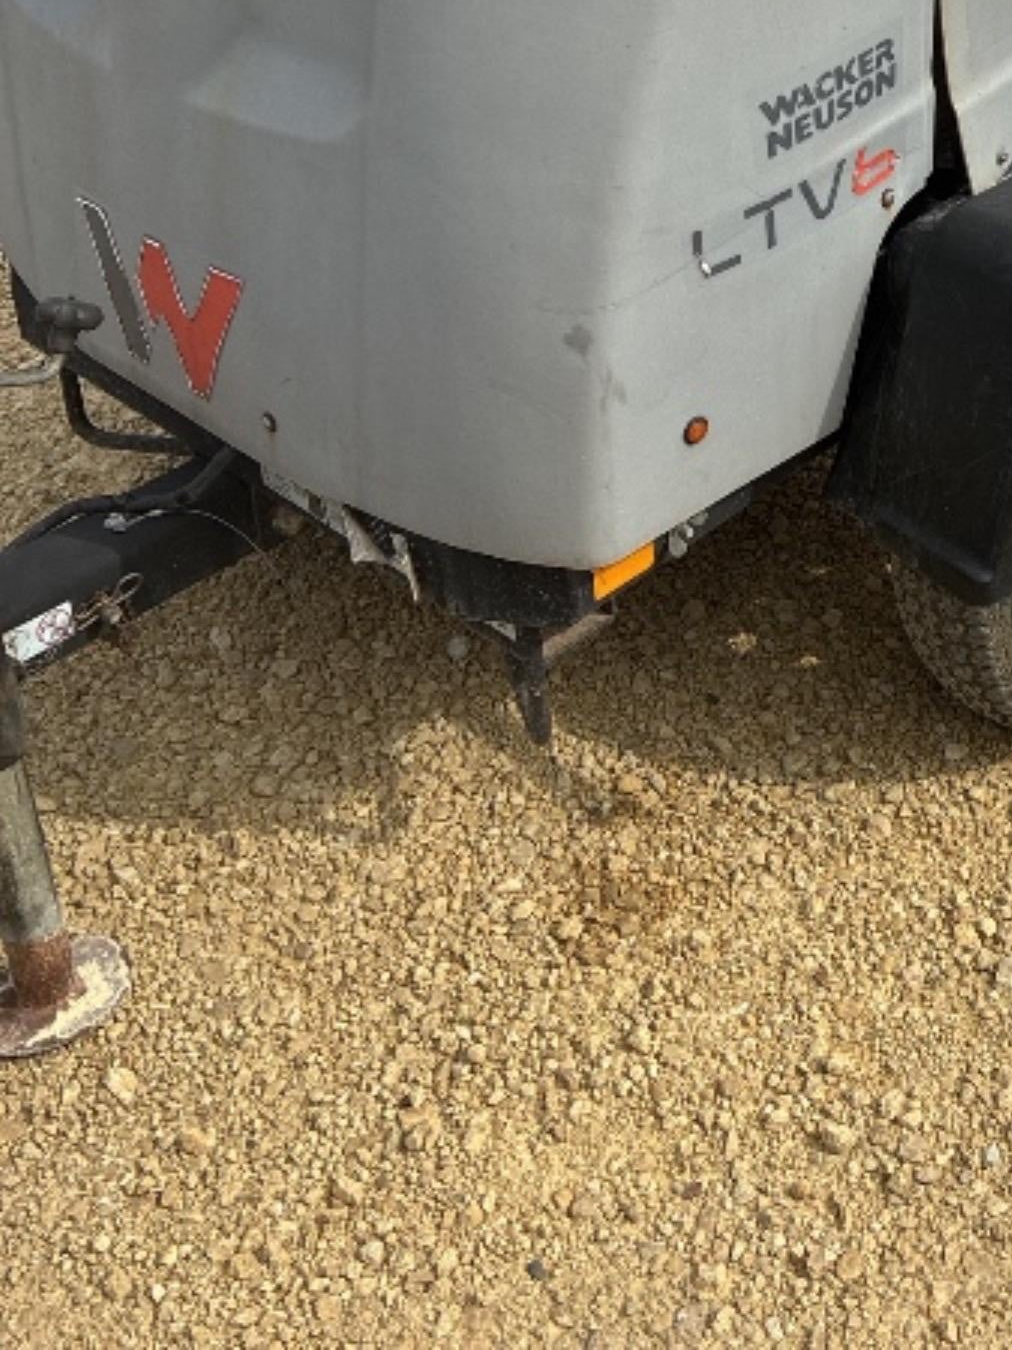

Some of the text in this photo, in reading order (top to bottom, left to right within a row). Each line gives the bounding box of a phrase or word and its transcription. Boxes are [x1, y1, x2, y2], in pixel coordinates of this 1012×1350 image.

[759, 38, 895, 126] WACKER
[767, 63, 897, 159] NEUSON
[693, 146, 899, 278] LTV6
